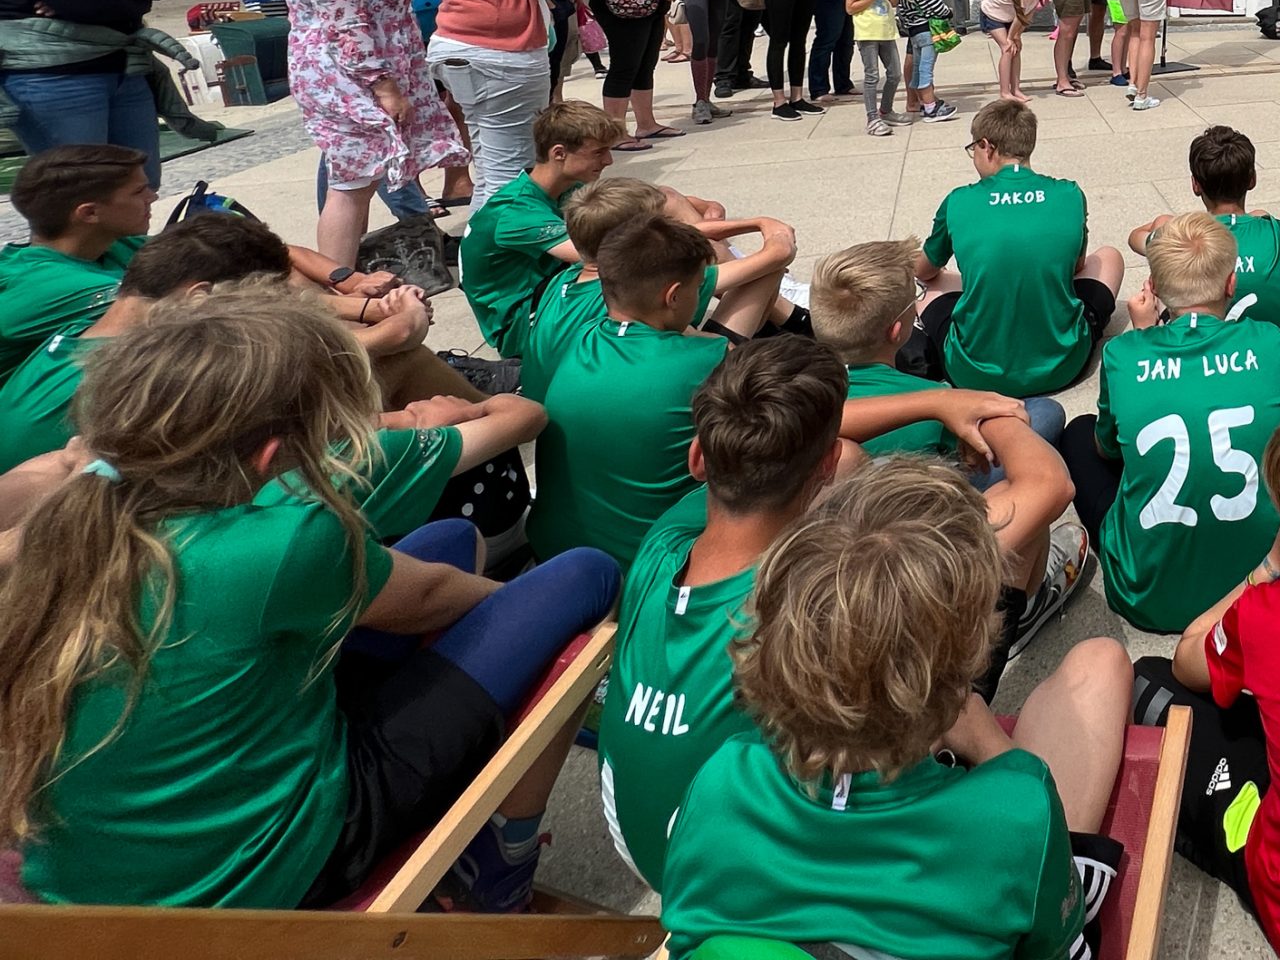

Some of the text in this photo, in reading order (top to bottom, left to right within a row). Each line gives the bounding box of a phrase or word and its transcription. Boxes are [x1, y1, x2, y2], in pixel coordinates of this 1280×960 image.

[988, 190, 1046, 207] JAKOB
[1235, 255, 1255, 273] AX
[1136, 349, 1259, 383] JAN LUCA
[1136, 404, 1260, 530] 25
[625, 681, 689, 736] NEIL
[1205, 757, 1227, 796] adidas
